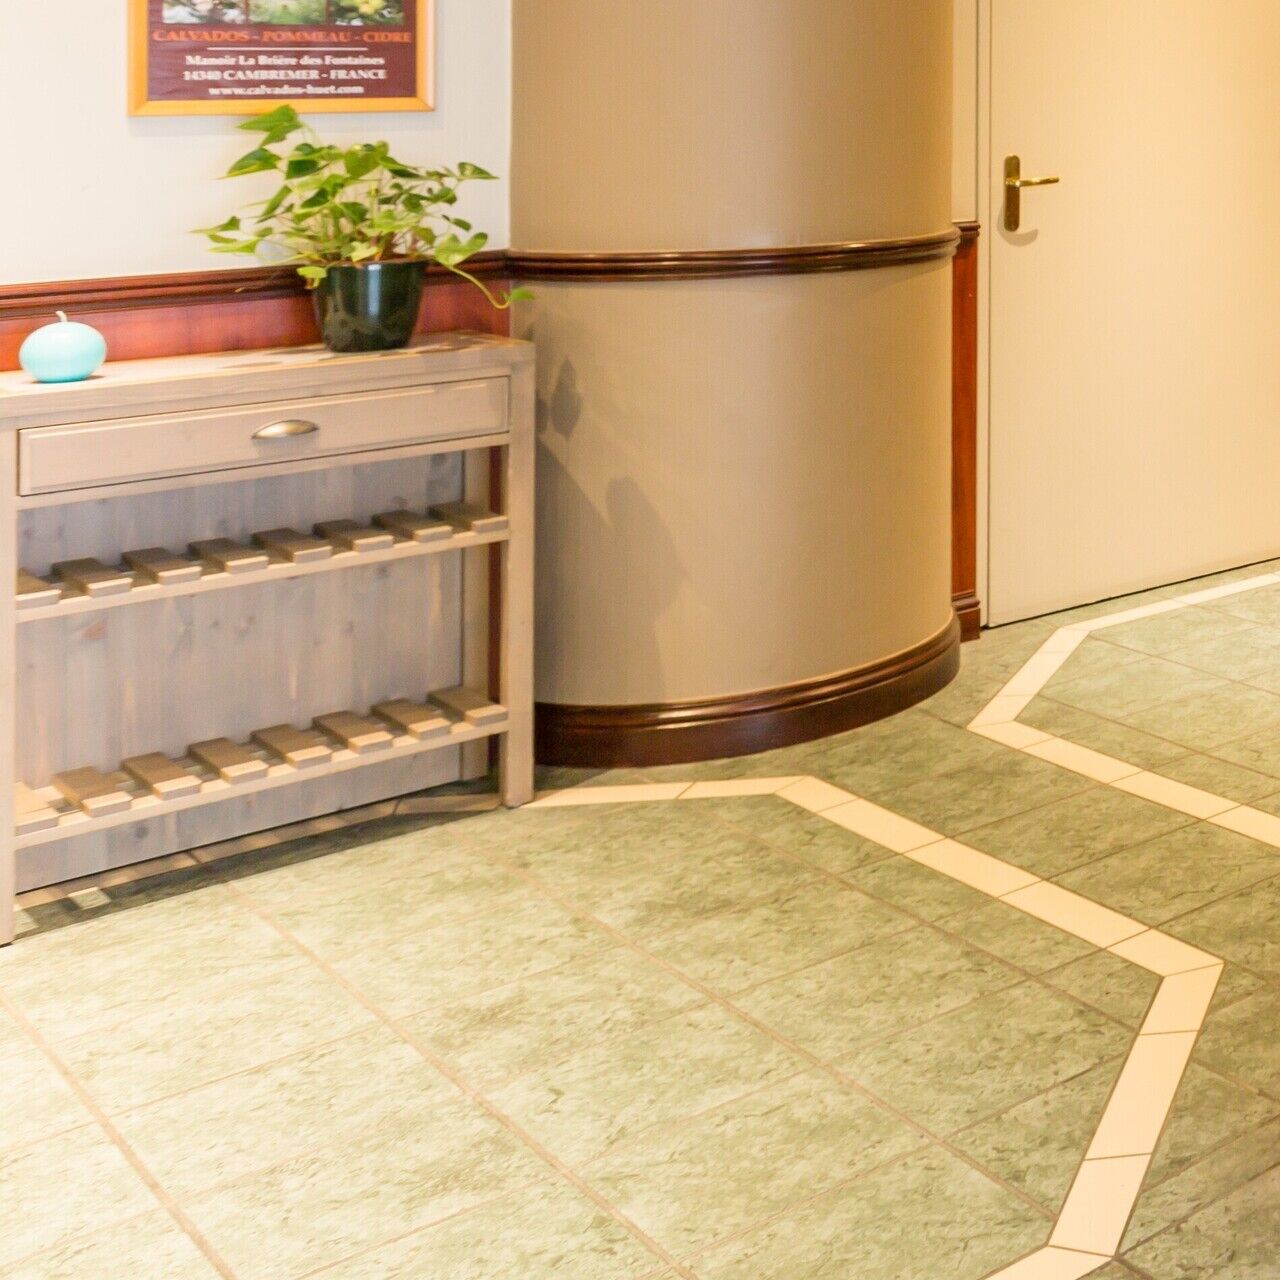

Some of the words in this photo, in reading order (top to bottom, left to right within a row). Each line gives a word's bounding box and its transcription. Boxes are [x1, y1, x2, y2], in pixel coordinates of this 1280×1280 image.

[153, 30, 250, 42] CALVADOS
[262, 30, 351, 42] POMMEAU
[363, 31, 411, 42] CIDRE
[185, 55, 237, 65] Manoir
[238, 55, 256, 65] La
[299, 55, 323, 65] des
[324, 55, 386, 65] Fontaines
[223, 70, 320, 81] CAMBREMER
[329, 69, 387, 80] FRANCE
[208, 84, 365, 96] www.calvados-huet.com
